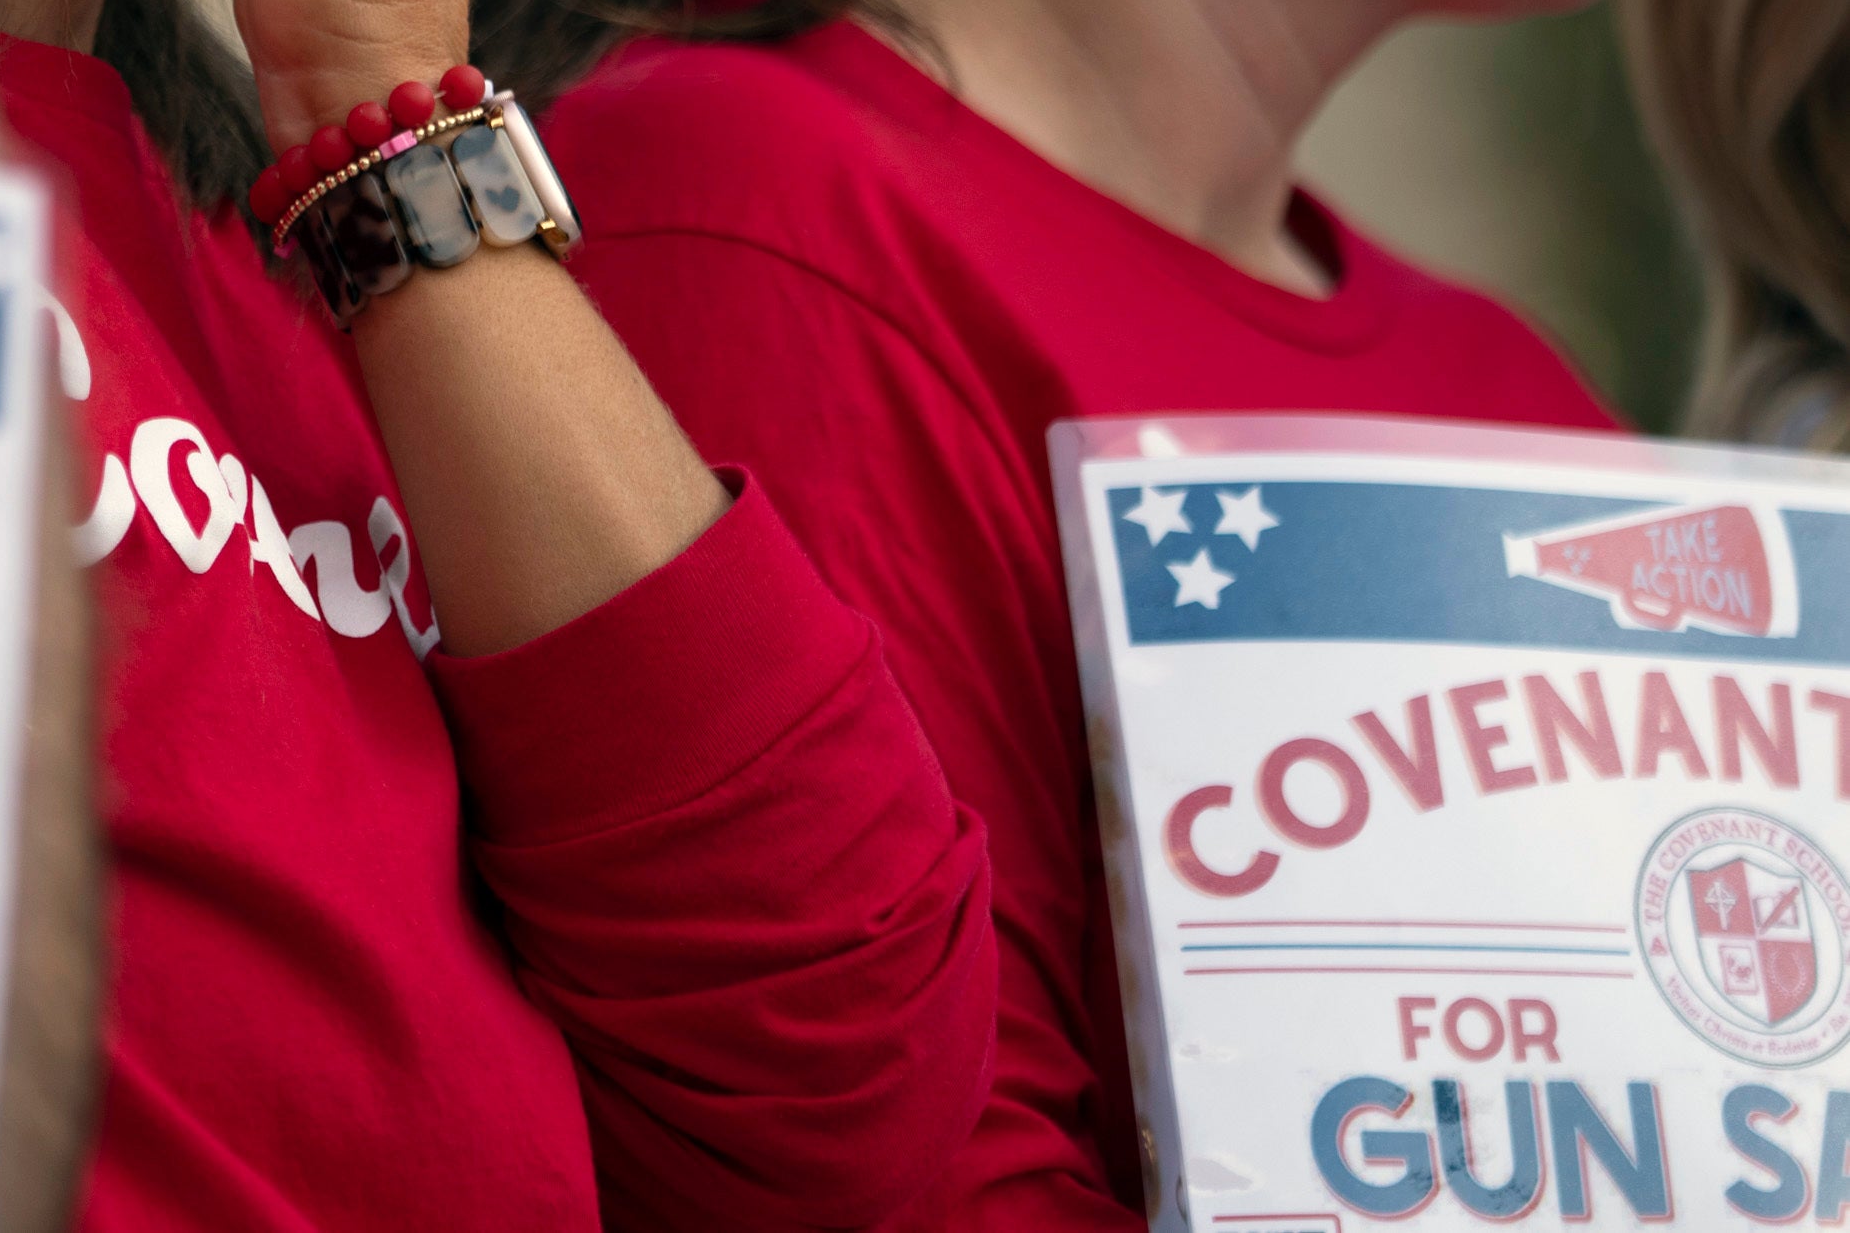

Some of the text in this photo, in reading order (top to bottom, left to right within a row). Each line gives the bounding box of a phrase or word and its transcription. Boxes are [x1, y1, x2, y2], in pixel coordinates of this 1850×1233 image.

[1645, 514, 1721, 563] TAKE
[1631, 562, 1752, 618] ACTION
[1162, 670, 1850, 900] COVENANT
[1644, 873, 1669, 927] THE
[1658, 818, 1782, 872] COVENANT
[1395, 995, 1562, 1065] FOR
[1310, 1074, 1675, 1224] GUN
